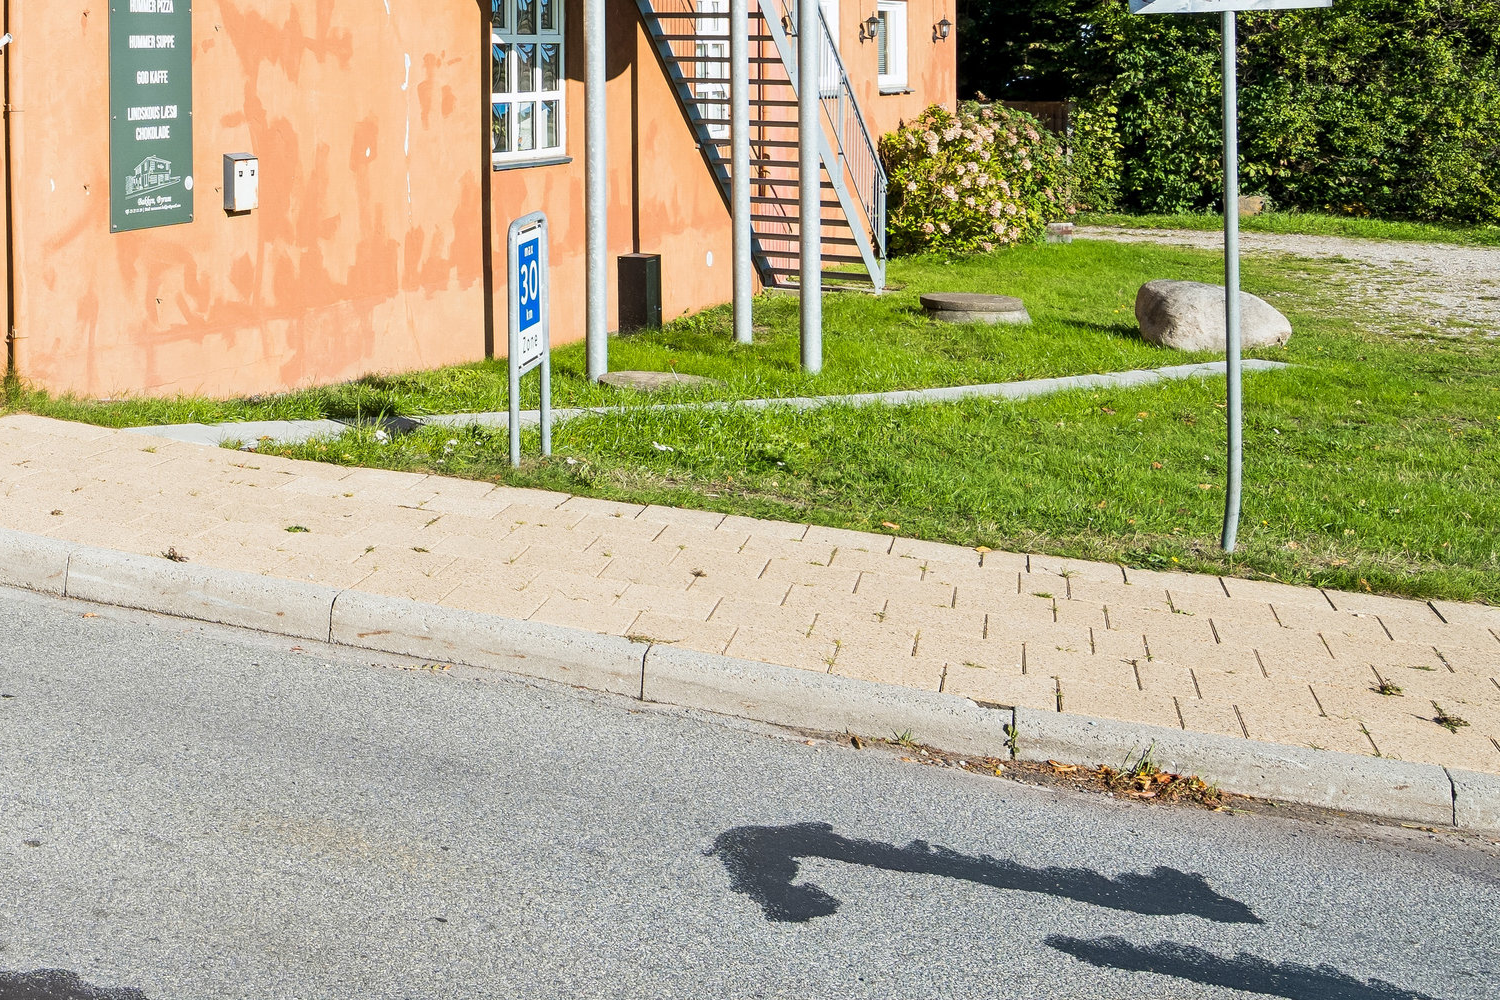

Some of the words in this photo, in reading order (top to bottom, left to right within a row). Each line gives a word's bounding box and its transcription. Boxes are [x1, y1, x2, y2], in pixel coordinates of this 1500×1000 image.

[156, 0, 174, 14] PIZZA
[129, 34, 156, 48] HUMMER
[156, 34, 175, 48] SUPPE
[136, 70, 150, 85] GOD
[150, 70, 169, 84] KAFFE
[135, 126, 170, 141] CHOKOLADE
[524, 245, 534, 257] max
[520, 259, 539, 306] 30
[525, 309, 533, 321] km
[522, 334, 539, 354] Zone
